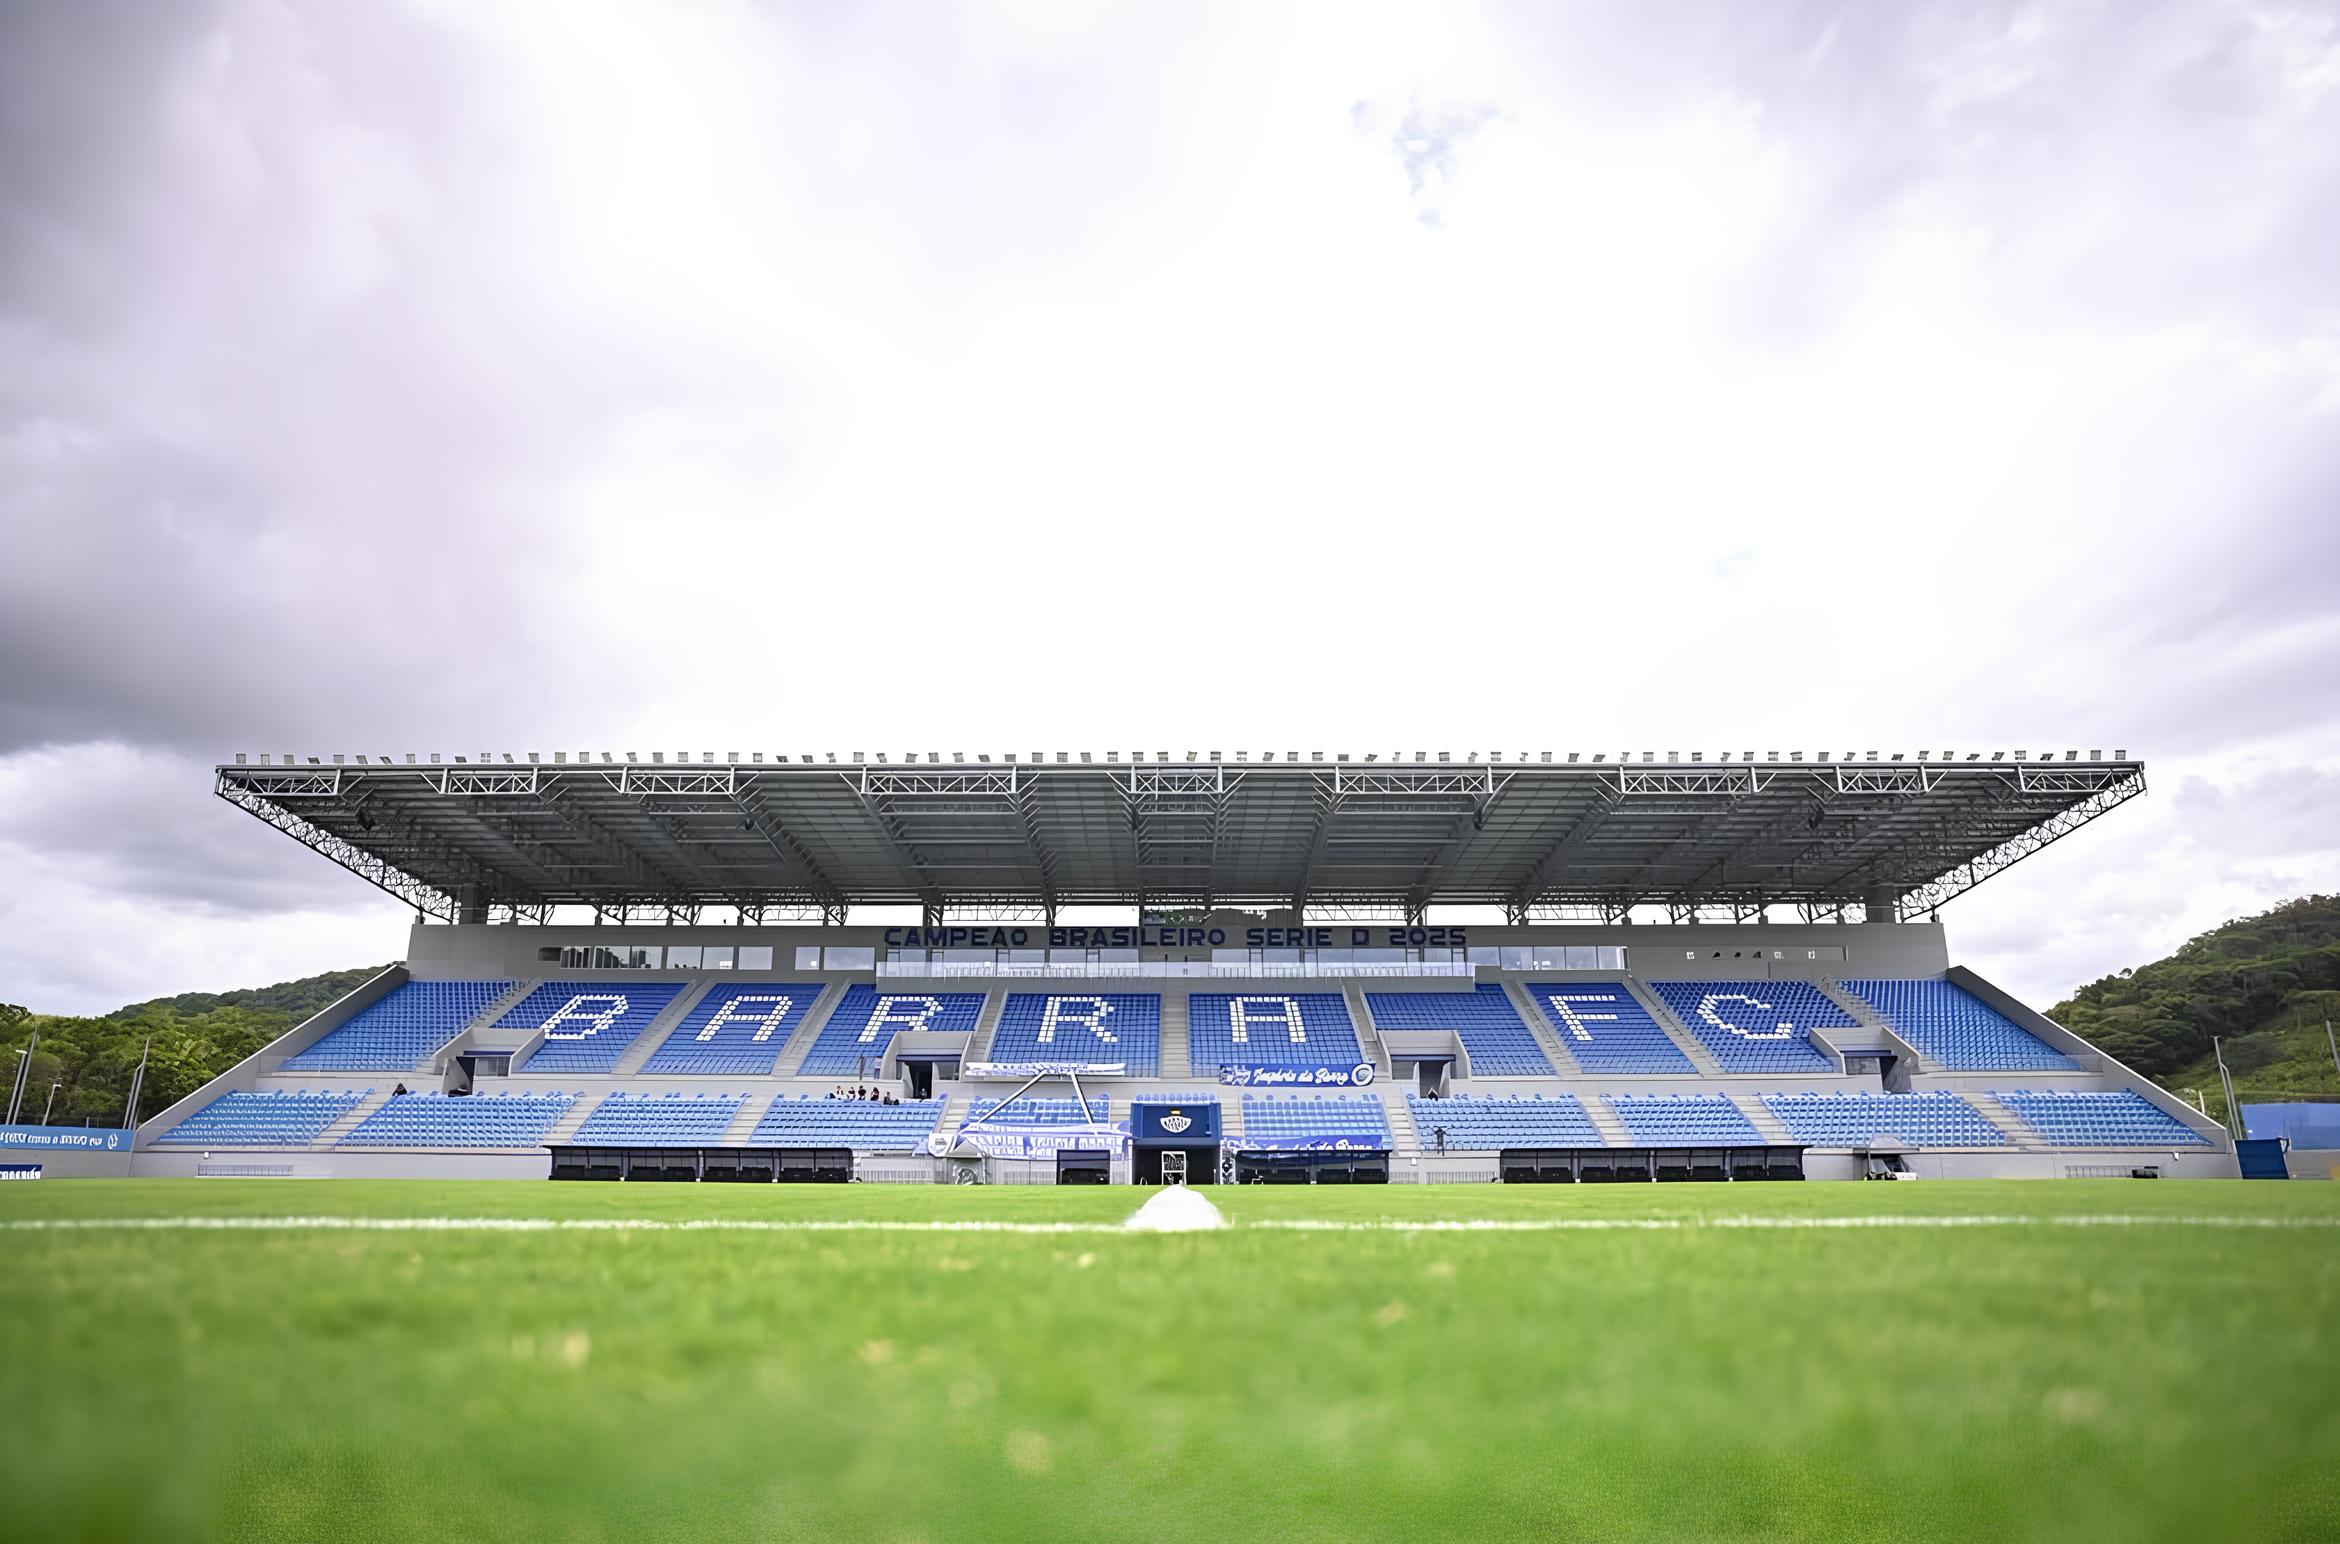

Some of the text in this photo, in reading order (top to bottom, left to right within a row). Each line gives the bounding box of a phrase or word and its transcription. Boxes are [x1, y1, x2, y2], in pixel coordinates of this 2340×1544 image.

[1050, 927, 1226, 947] BRASILEIRO
[1246, 928, 1333, 947] SERIE
[1352, 928, 1370, 946] D
[1389, 928, 1466, 946] 2025
[541, 994, 1793, 1042] BARRA FC
